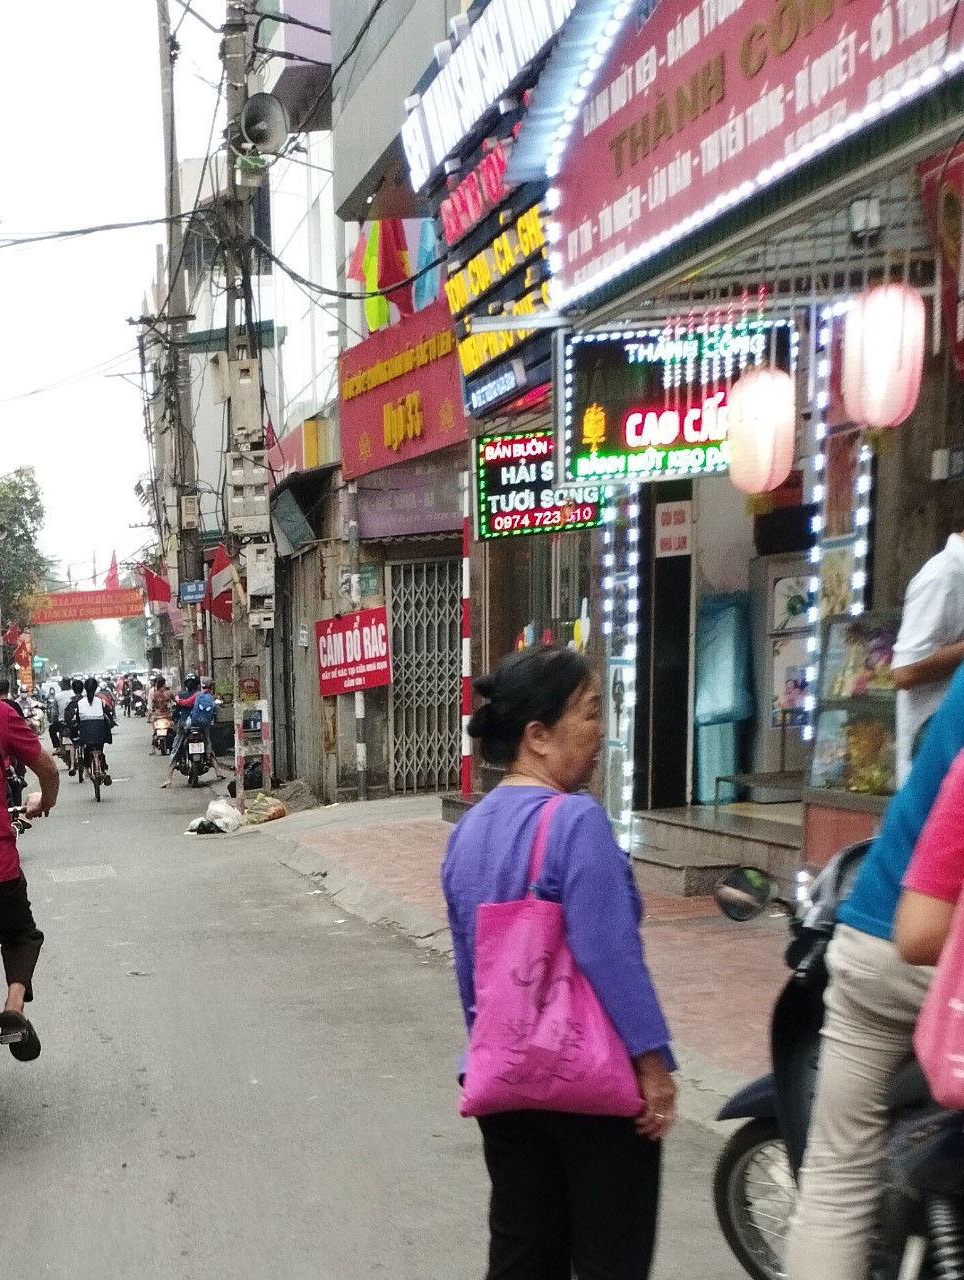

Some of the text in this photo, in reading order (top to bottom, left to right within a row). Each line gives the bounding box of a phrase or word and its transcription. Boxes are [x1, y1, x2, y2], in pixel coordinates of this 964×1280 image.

[626, 411, 679, 448] CAO
[485, 439, 547, 460] BÁN BUÔN
[501, 458, 536, 485] HẢI
[576, 450, 626, 475] BÁNH
[487, 489, 535, 514] TƯƠI
[494, 514, 531, 530] 0974
[534, 511, 561, 526] 723
[319, 623, 344, 668] CẤM
[345, 616, 361, 663] ĐỔ
[363, 618, 386, 659] RÁC
